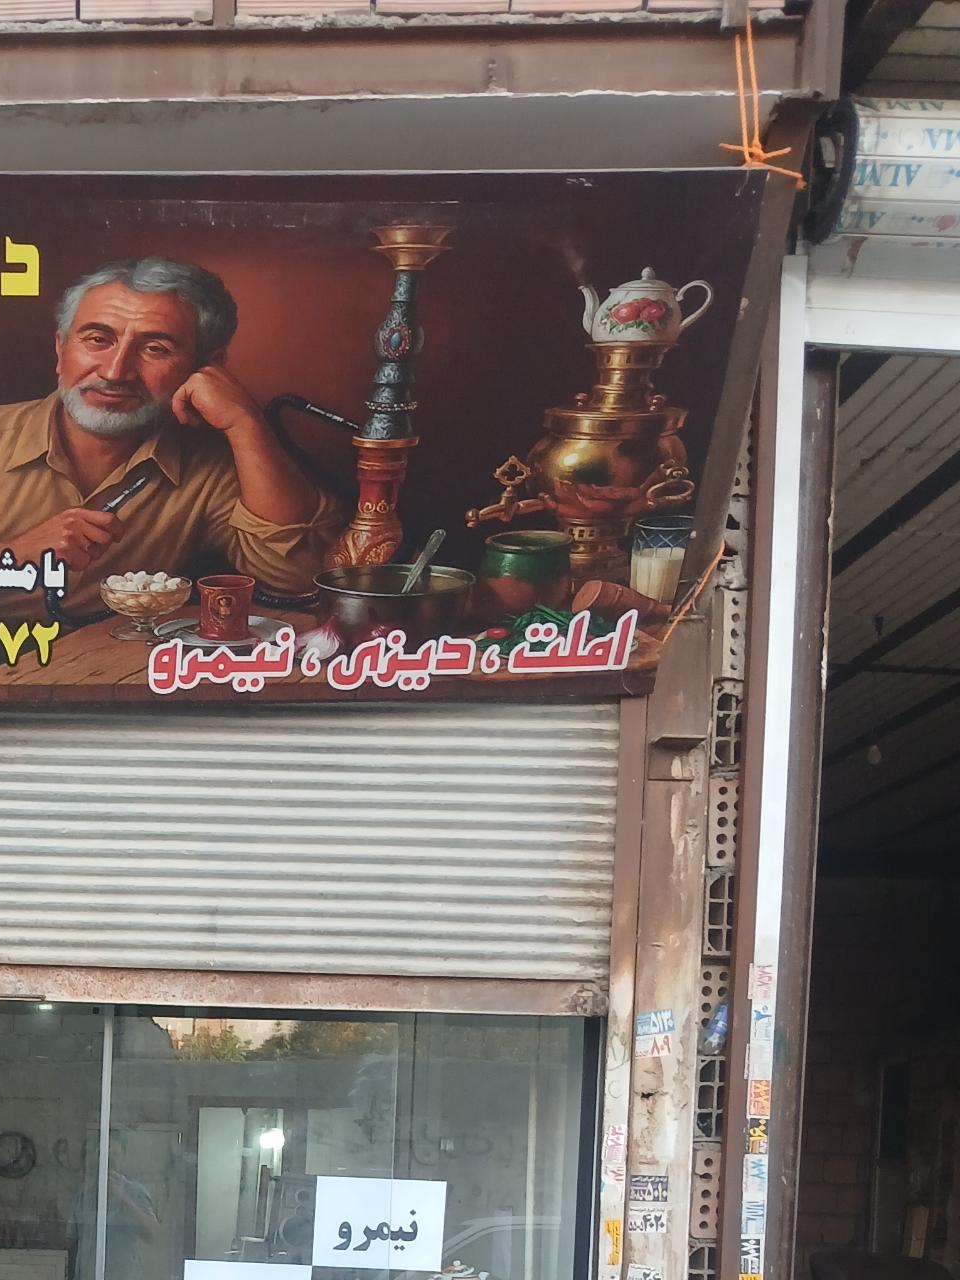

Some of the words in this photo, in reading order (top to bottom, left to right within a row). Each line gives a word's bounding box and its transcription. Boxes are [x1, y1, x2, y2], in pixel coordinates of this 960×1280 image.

[42, 550, 66, 599] با
[147, 625, 295, 694] نیمرو
[332, 1208, 419, 1252] نیمرو
